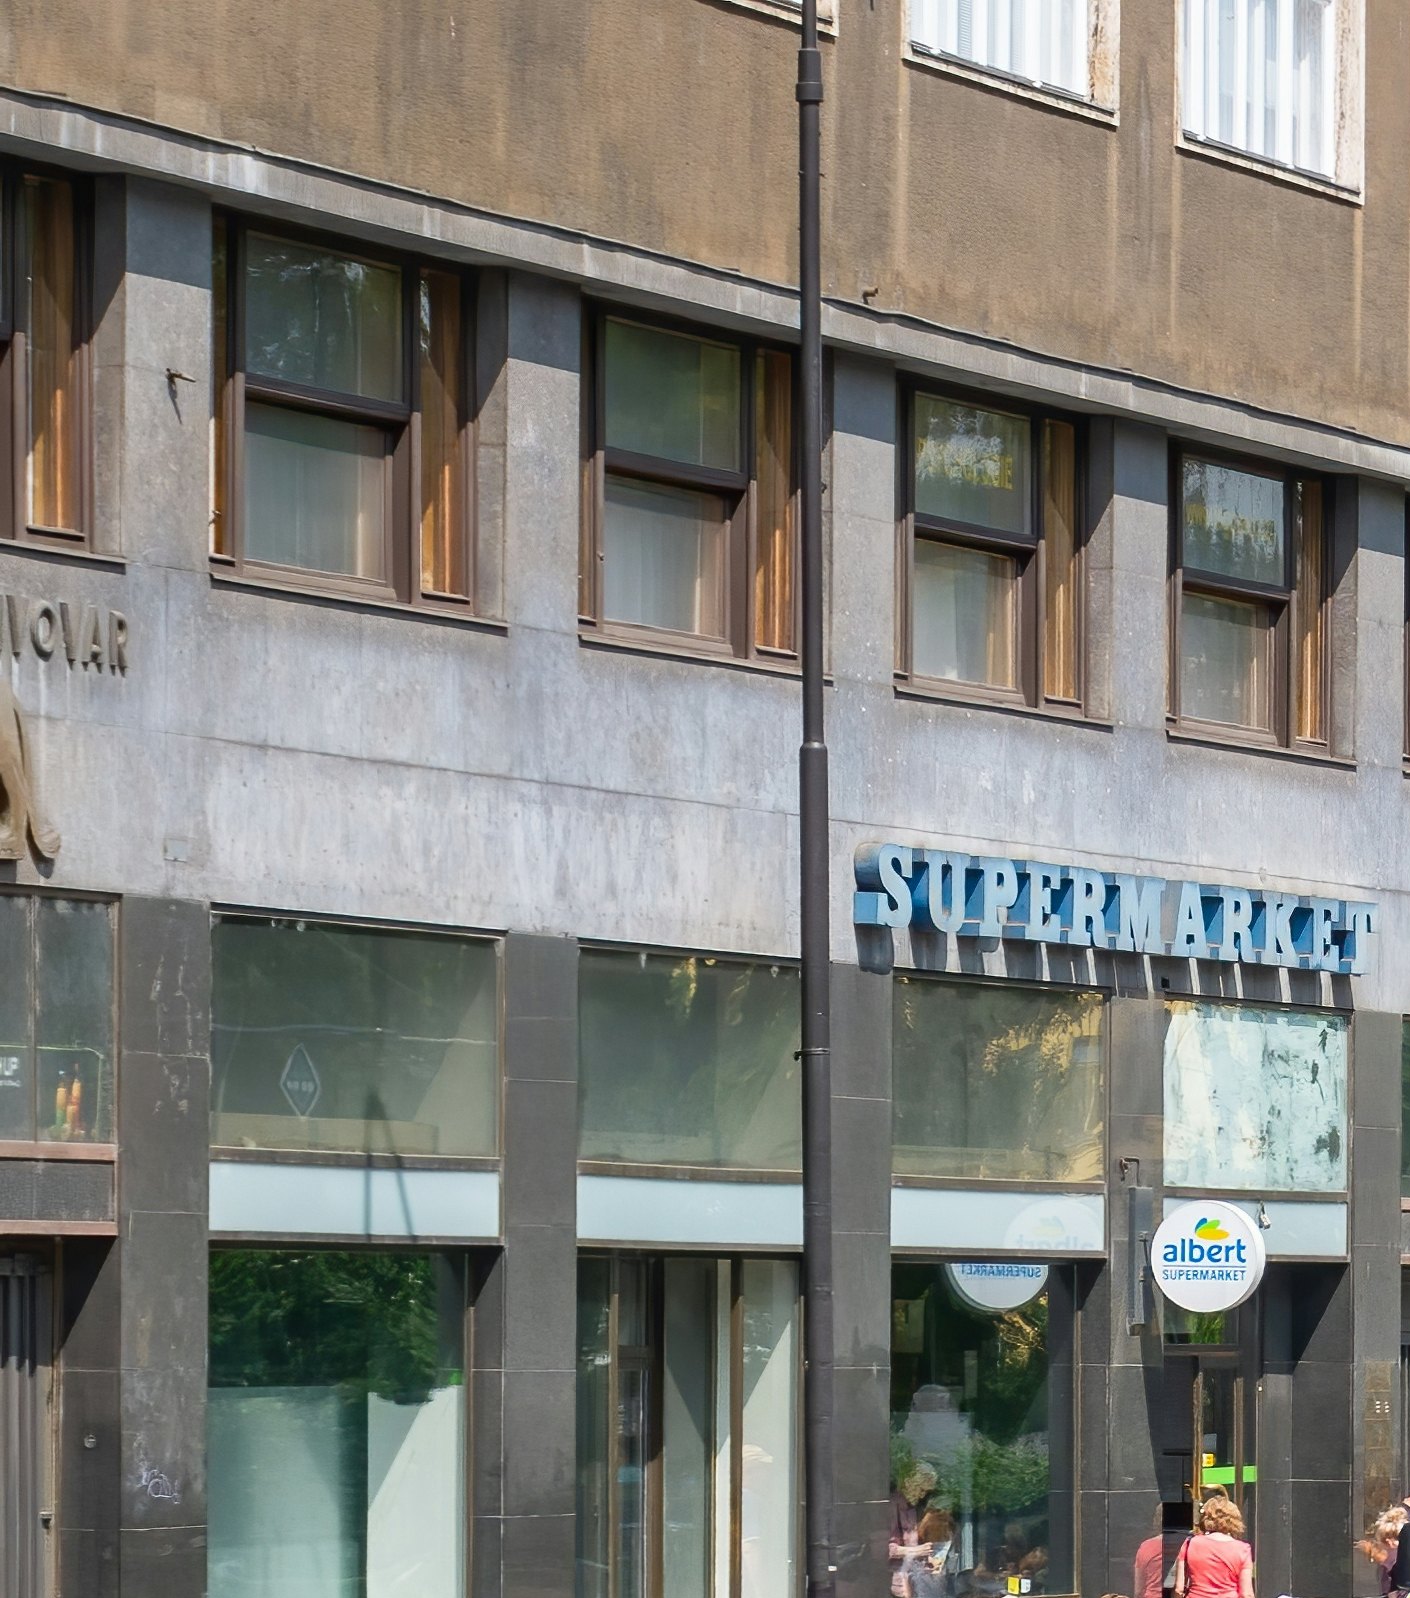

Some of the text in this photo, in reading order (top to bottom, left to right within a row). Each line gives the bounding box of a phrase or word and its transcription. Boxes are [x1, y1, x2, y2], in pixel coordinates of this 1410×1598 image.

[0, 594, 128, 671] VOVAR
[858, 843, 1378, 975] SUPERMARKET
[1162, 1269, 1247, 1281] SUPERMARKET
[1163, 1237, 1247, 1263] albert
